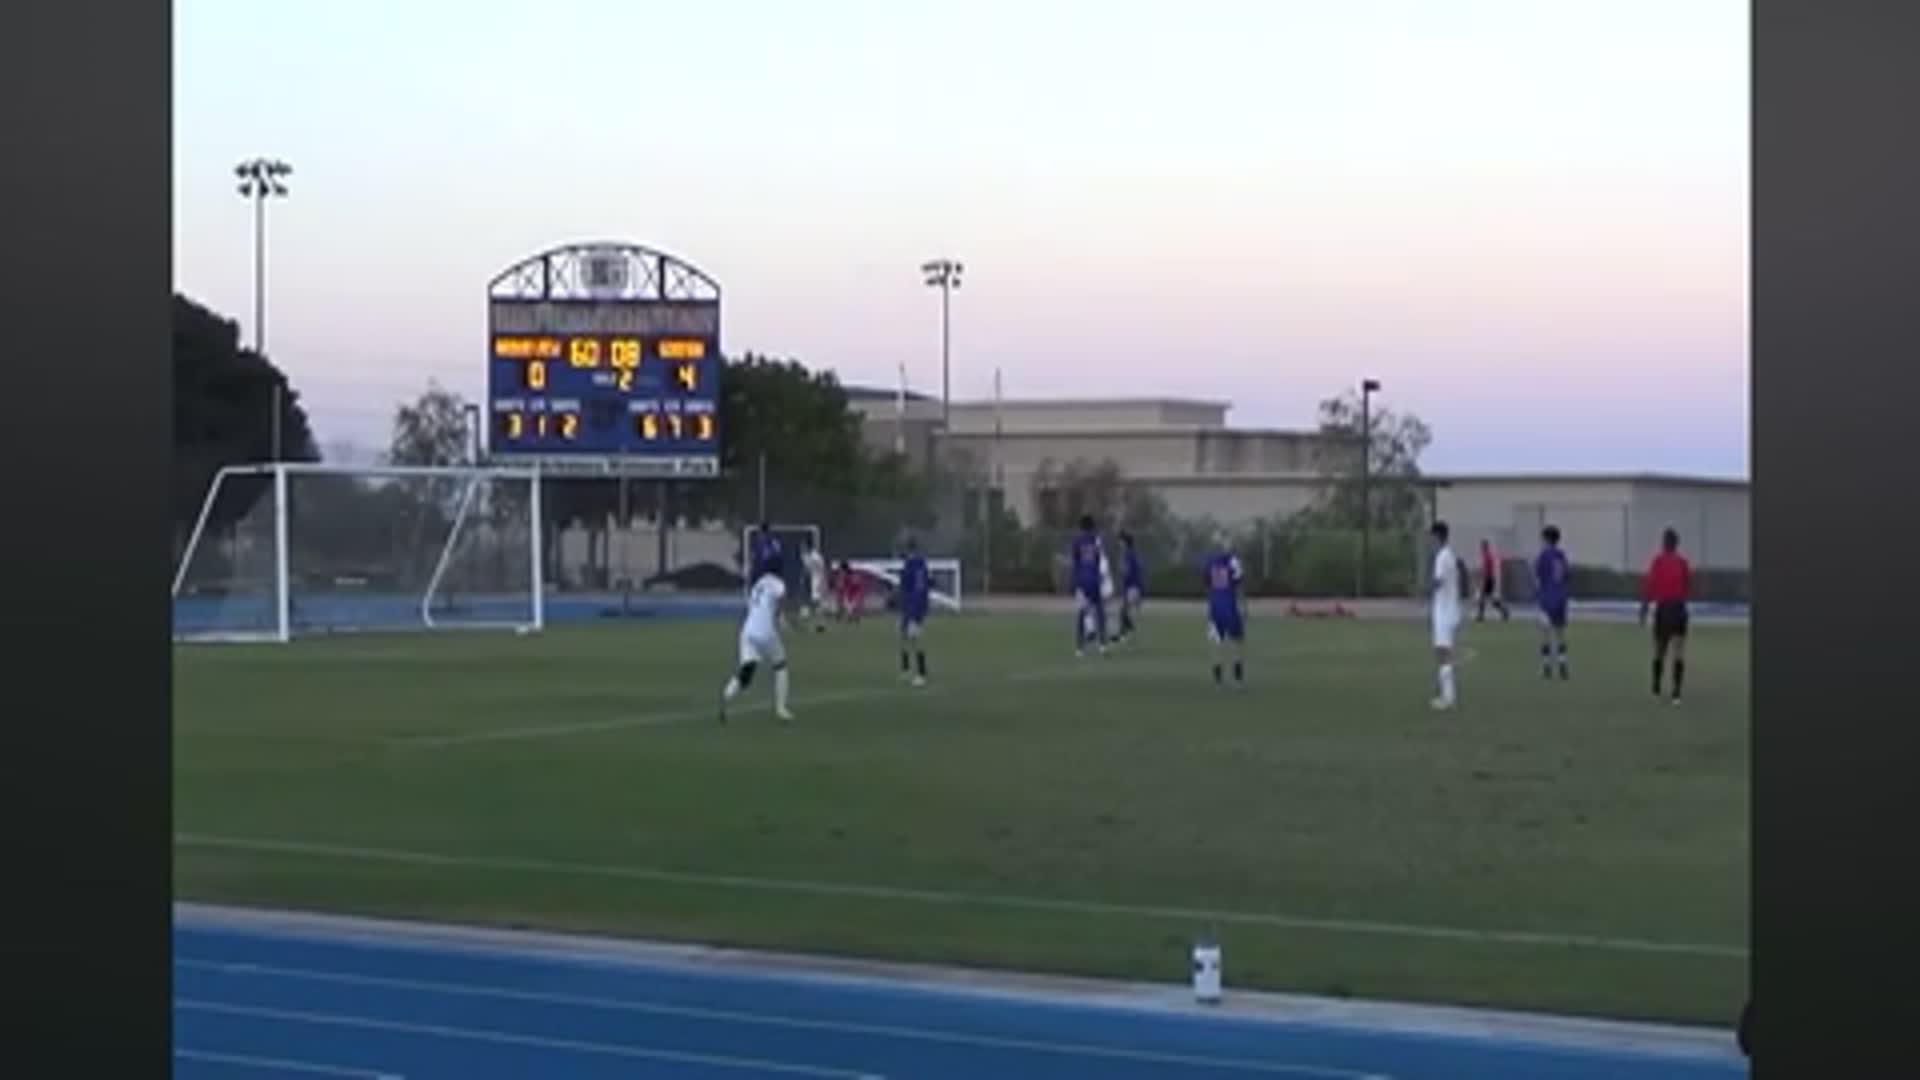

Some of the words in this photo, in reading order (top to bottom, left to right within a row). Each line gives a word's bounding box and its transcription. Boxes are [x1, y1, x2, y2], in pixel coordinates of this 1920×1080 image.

[528, 361, 545, 389] 0
[619, 369, 632, 391] 2
[677, 364, 695, 390] 4
[560, 413, 577, 439] 2
